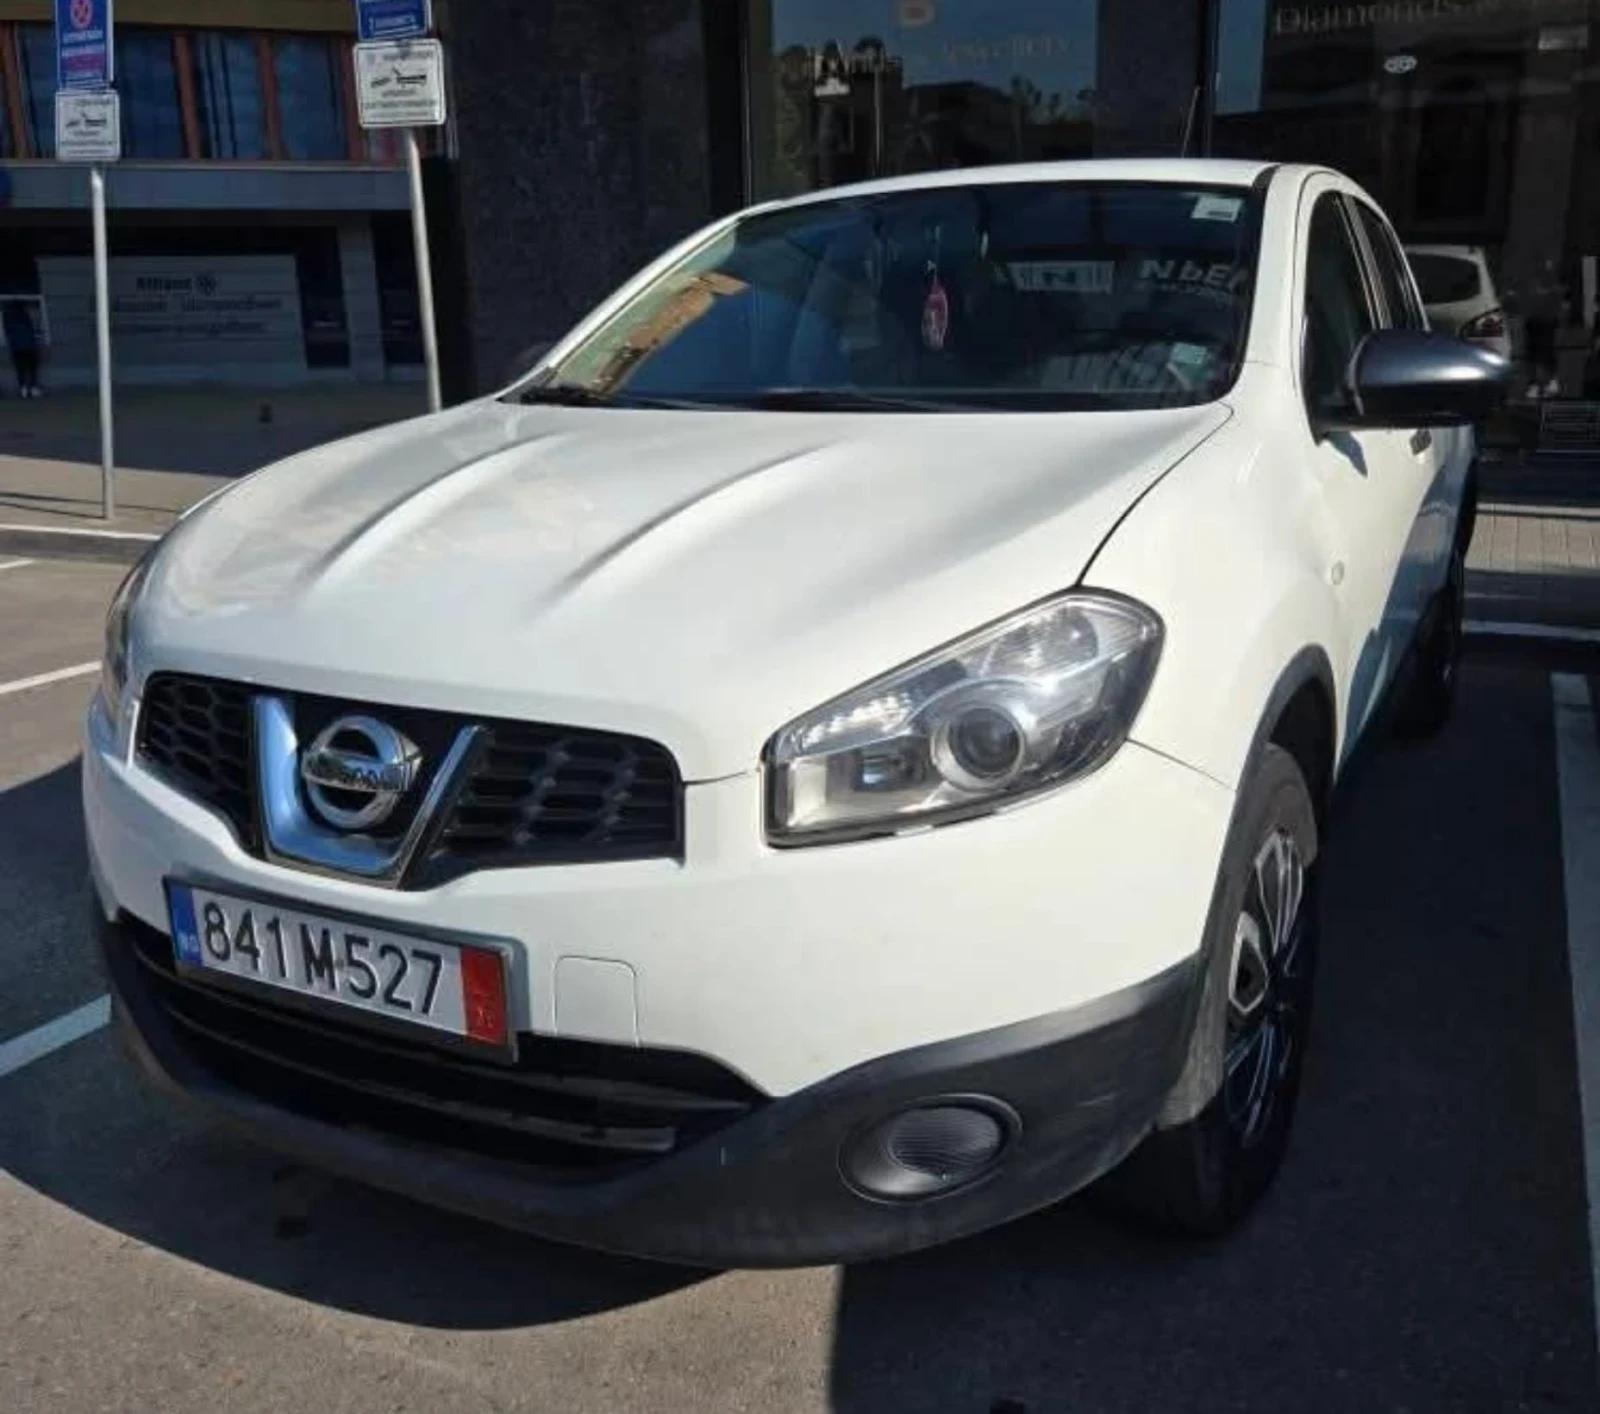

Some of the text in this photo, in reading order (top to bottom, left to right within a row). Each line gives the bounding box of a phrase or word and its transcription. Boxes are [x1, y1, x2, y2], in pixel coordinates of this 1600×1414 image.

[203, 901, 287, 978] 841
[299, 923, 338, 992] M
[344, 933, 443, 1015] 527
